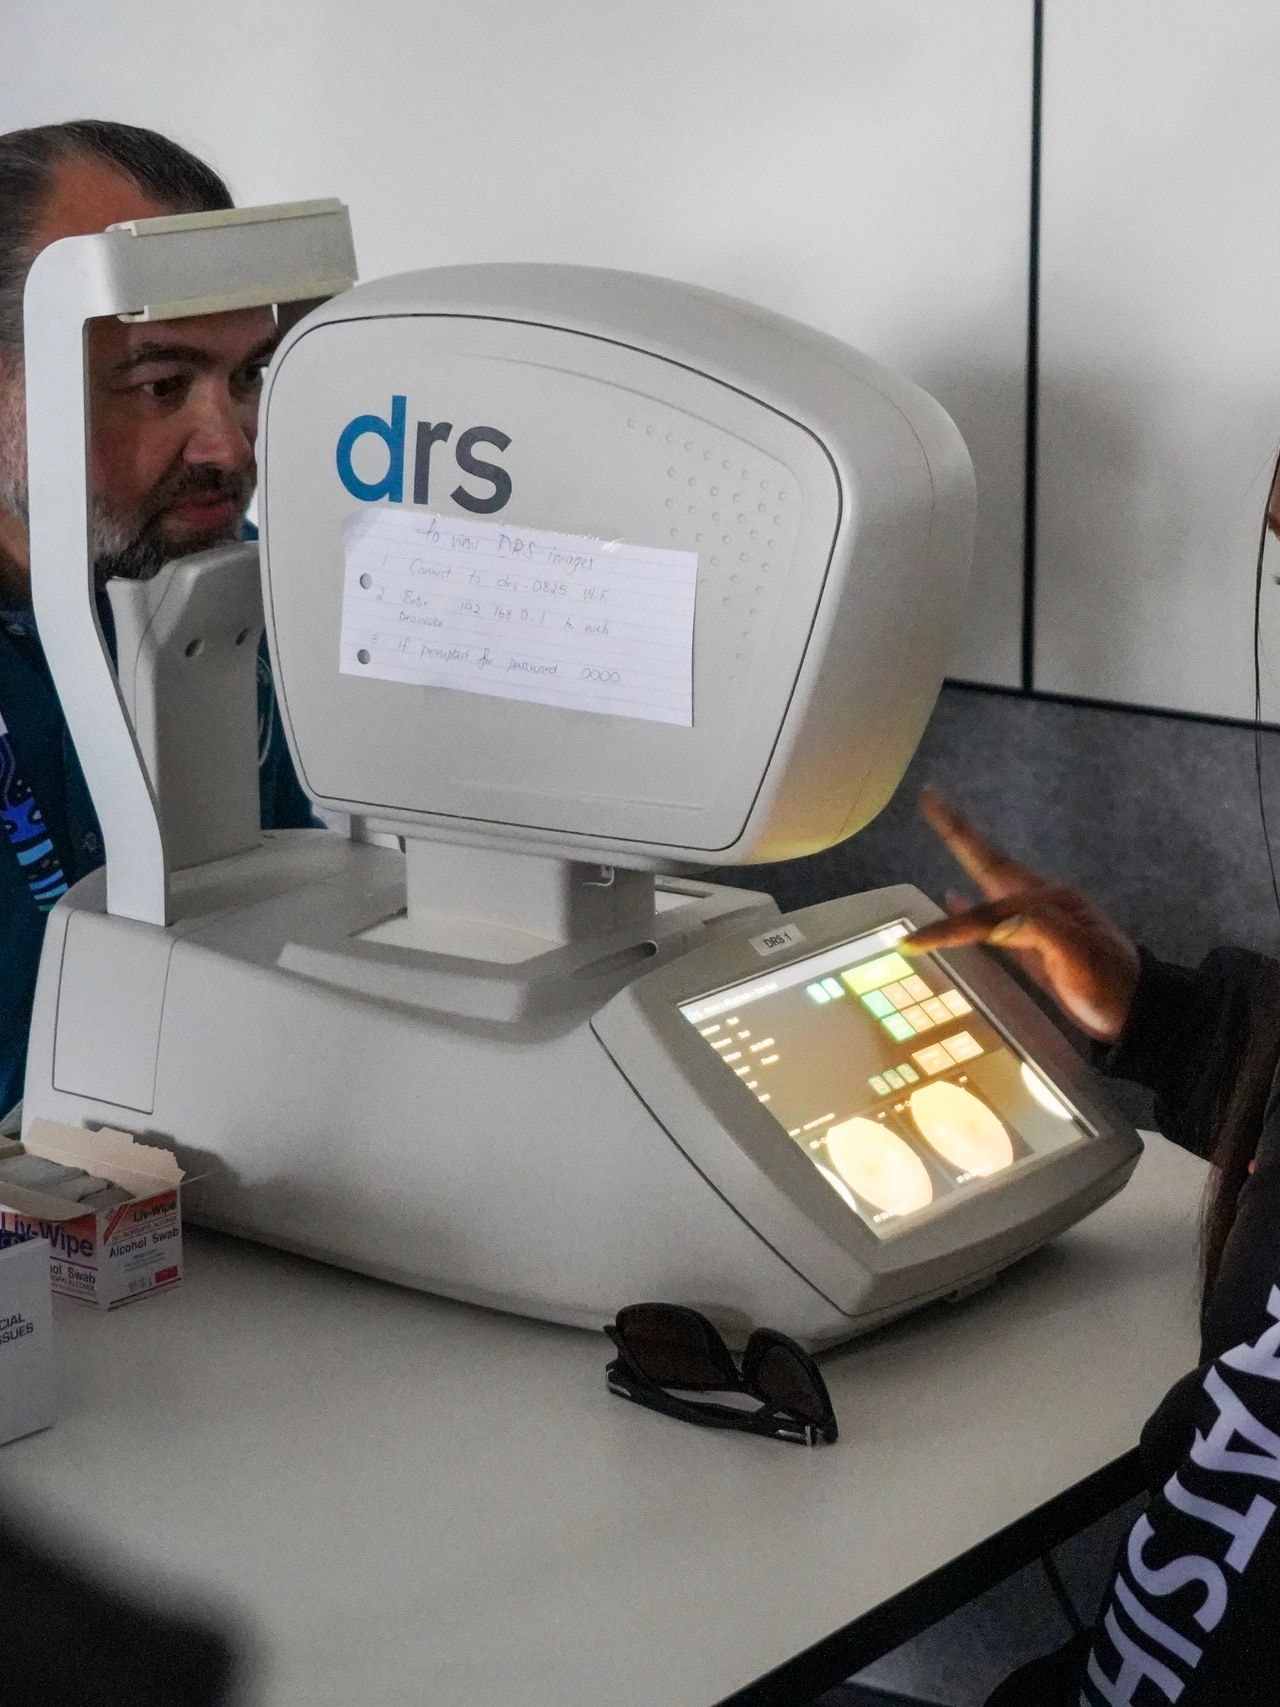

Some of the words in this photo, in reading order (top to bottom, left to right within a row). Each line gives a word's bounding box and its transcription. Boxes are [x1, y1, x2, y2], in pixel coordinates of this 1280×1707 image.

[336, 394, 513, 514] drs
[548, 547, 594, 575] images
[468, 569, 482, 585] to
[505, 657, 560, 674] password
[763, 934, 786, 948] DRS
[133, 1201, 178, 1222] Liv-Wipe
[109, 1236, 147, 1258] Alcohol
[151, 1227, 180, 1243] Swab
[68, 1265, 96, 1285] Swab
